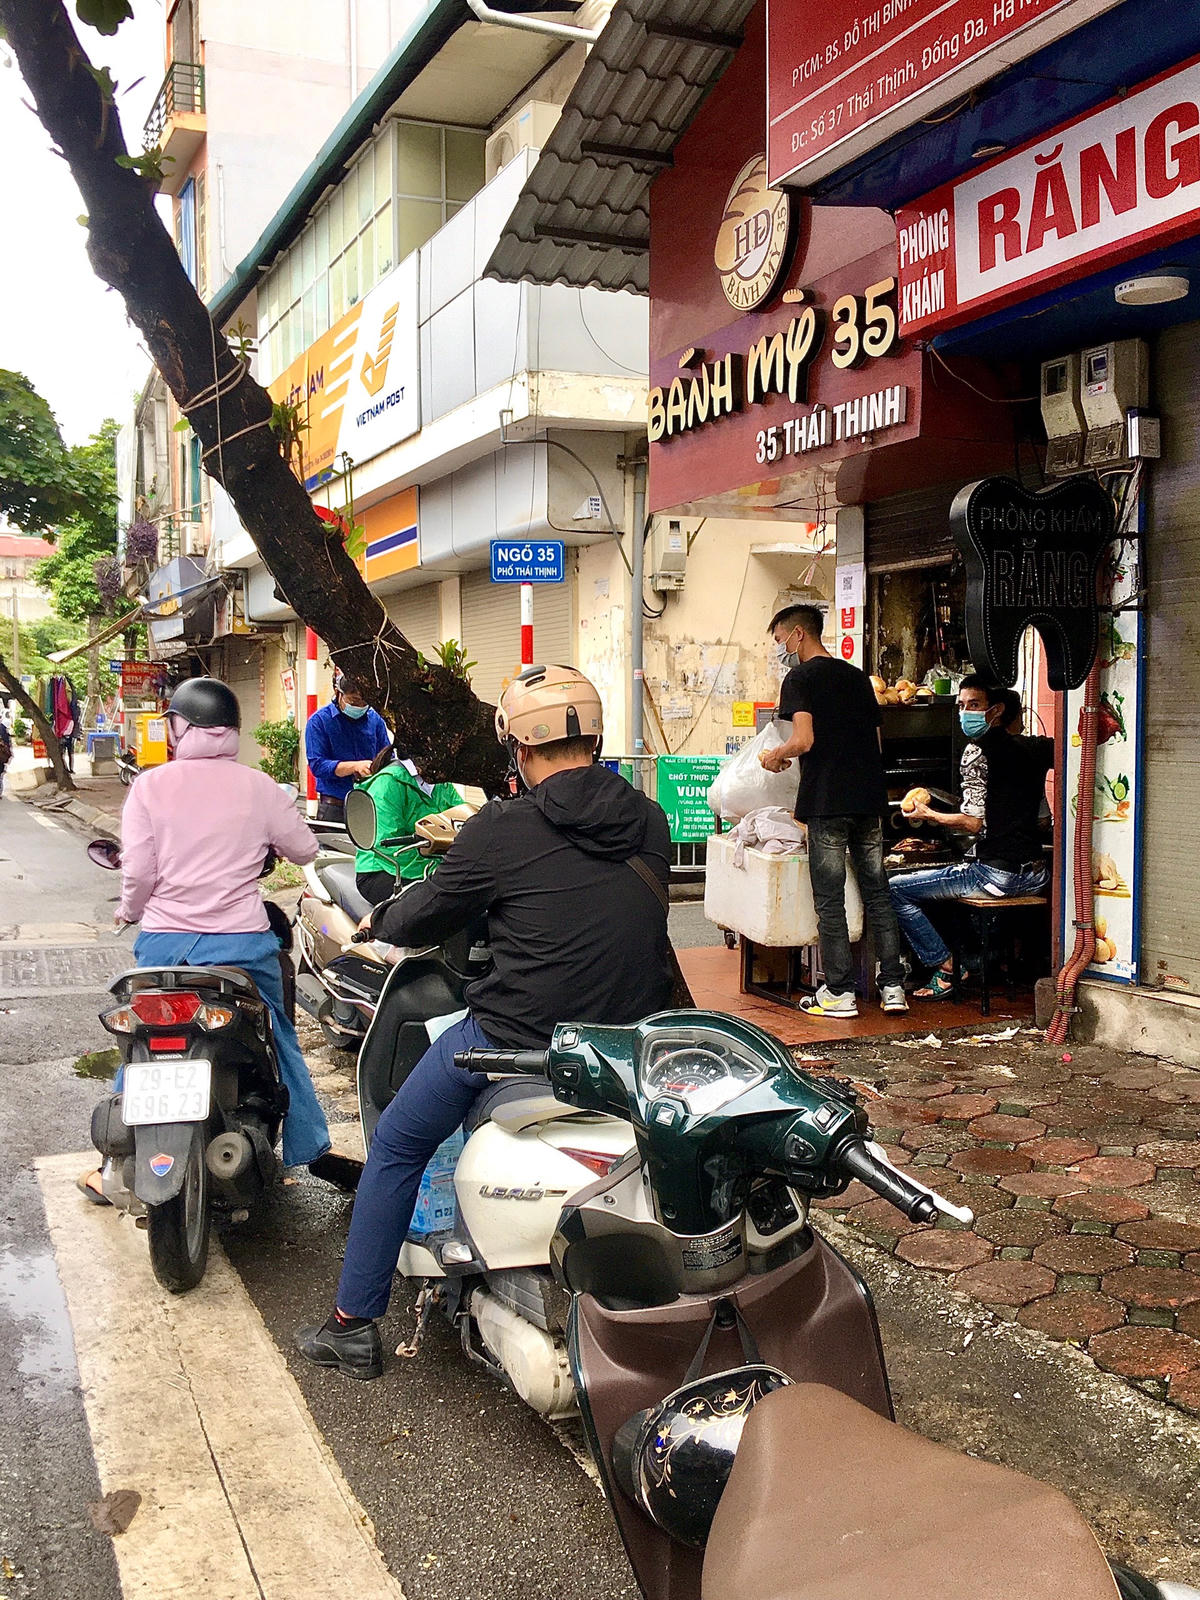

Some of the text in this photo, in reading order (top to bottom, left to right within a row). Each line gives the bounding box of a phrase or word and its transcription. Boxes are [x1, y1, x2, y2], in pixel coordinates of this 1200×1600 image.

[792, 53, 824, 87] PTCM:
[825, 39, 842, 65] BS.
[844, 17, 860, 52] ĐỖ
[862, 9, 881, 38] THỊ
[791, 130, 808, 153] Đc:
[810, 109, 827, 141] Số
[828, 102, 844, 131] 37
[847, 82, 874, 118] Thái
[876, 60, 918, 95] Thịnh,
[921, 34, 960, 71] Đống
[963, 19, 988, 45] Đa,
[977, 101, 1200, 274] RĂNG
[726, 276, 761, 305] BÁNH
[777, 205, 787, 233] 35
[899, 207, 950, 269] PHÒNG
[901, 266, 946, 325] KHÁM
[647, 347, 735, 443] BÁNH
[831, 276, 896, 369] 35
[356, 386, 406, 428] VIETNAM POST
[755, 385, 902, 465] 35 THÁI THỊNH
[980, 501, 1102, 532] PHÒNG KHÁM
[497, 563, 557, 578] PHỐ THÁI THỊNH
[498, 544, 555, 562] NGÕ 35
[993, 537, 1089, 607] RĂNG
[668, 772, 688, 781] CHỐT
[690, 773, 710, 782] THỰC
[130, 1091, 204, 1119] 696.23
[138, 1066, 197, 1091] 29-E2
[479, 1184, 545, 1201] LEAD
